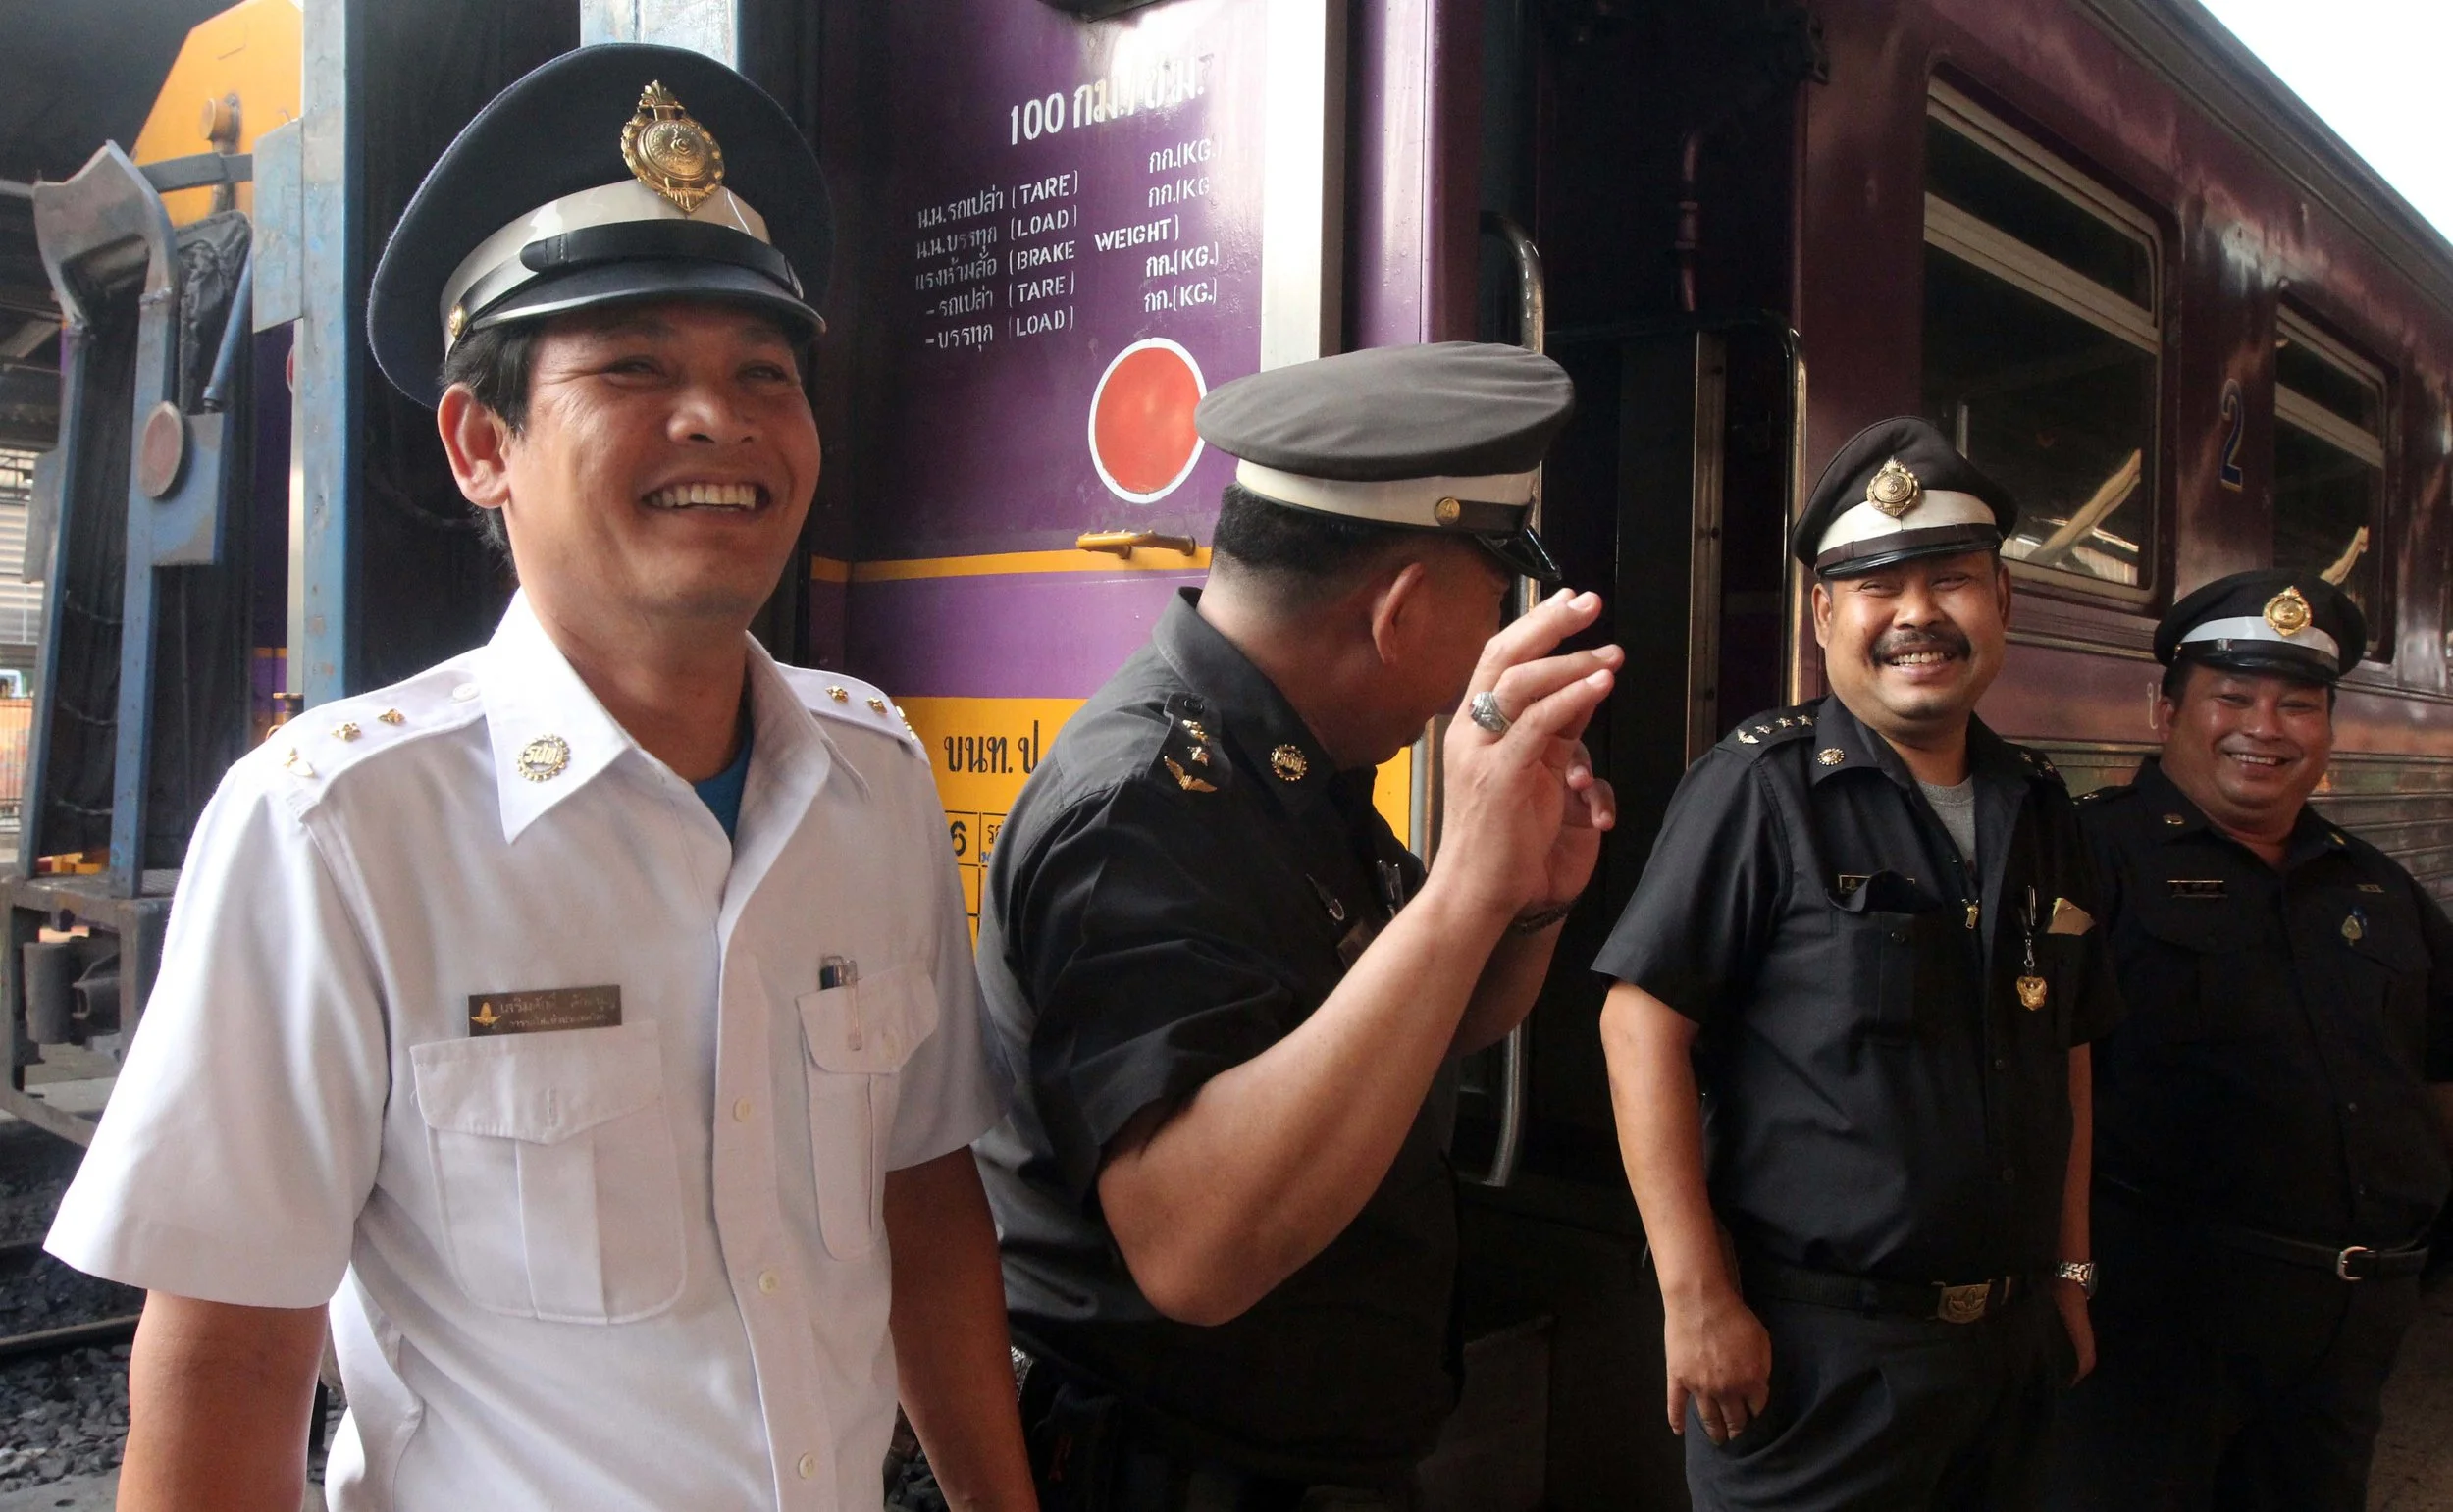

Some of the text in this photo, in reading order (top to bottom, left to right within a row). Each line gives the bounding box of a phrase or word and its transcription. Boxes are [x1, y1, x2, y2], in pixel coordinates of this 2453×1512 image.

[1010, 92, 1066, 146] 100
[1009, 240, 1076, 276] (BRAKE
[1094, 213, 1179, 252] WEIGHT)
[2220, 378, 2244, 492] 2
[949, 820, 966, 857] 6
